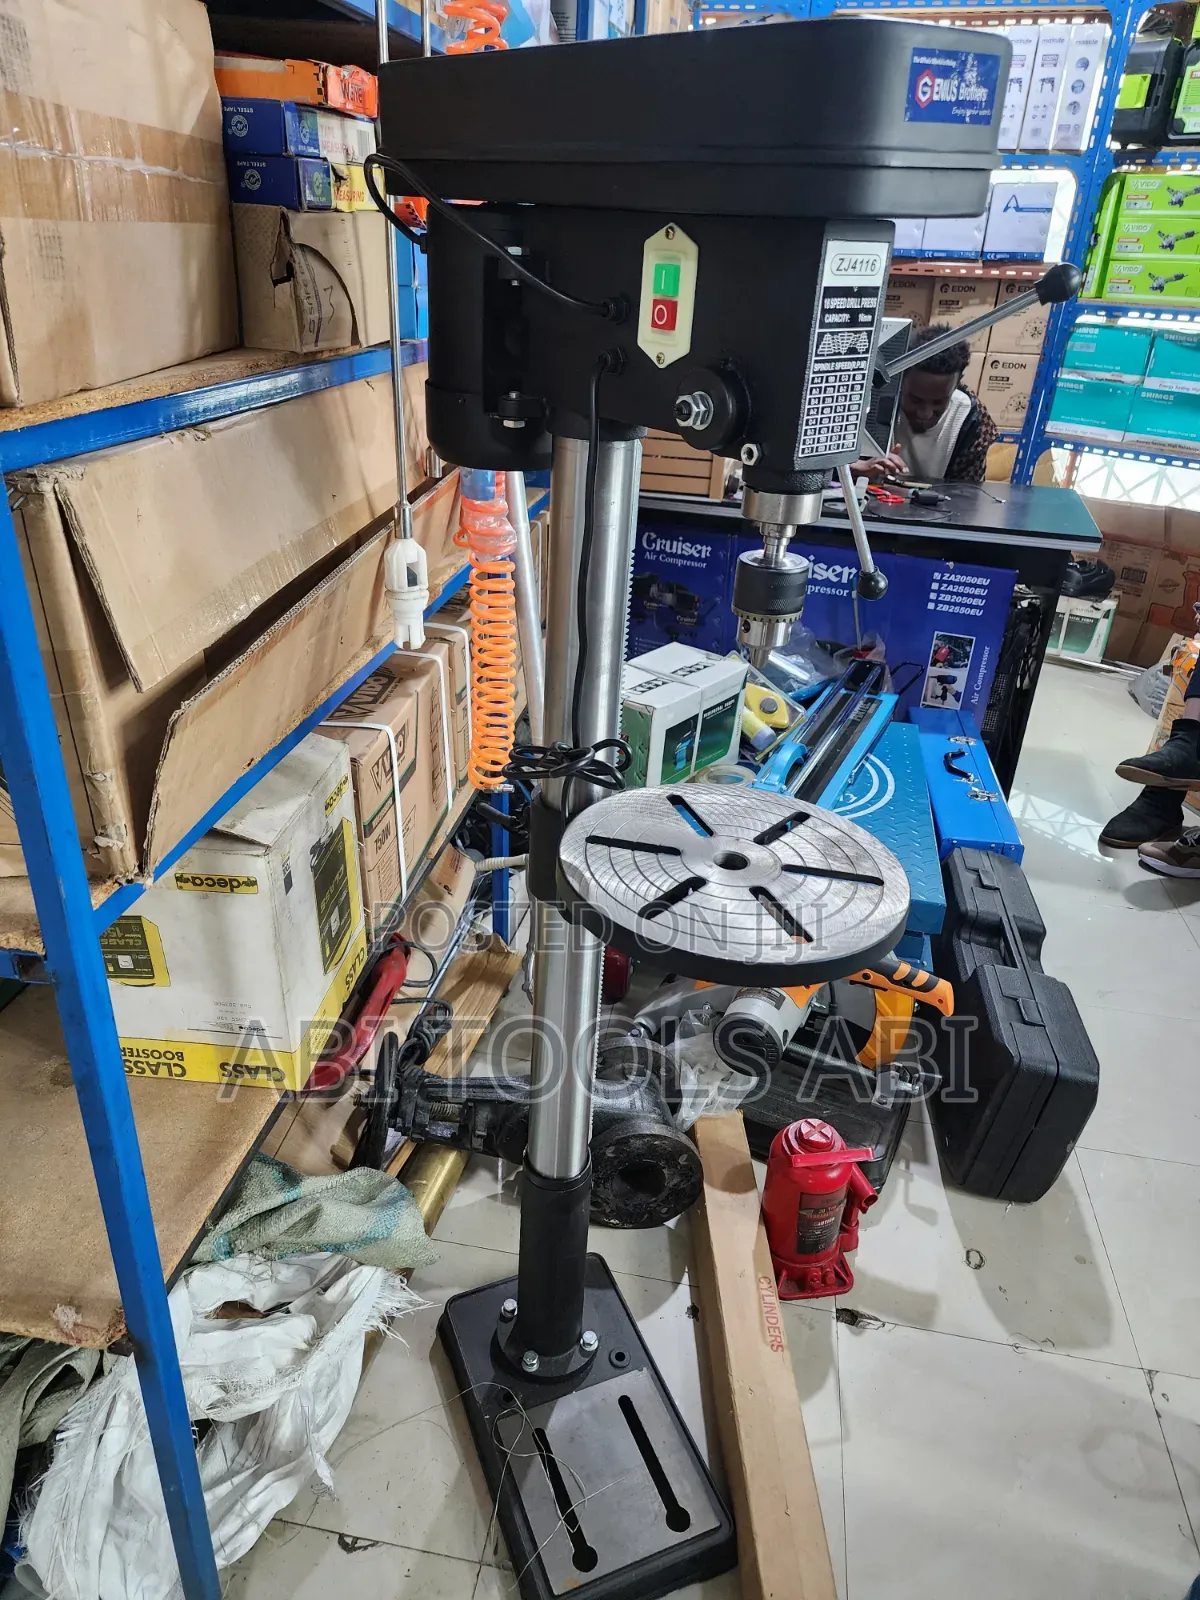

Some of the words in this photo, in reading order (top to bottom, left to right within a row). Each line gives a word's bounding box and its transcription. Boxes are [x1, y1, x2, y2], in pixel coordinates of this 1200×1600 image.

[836, 257, 878, 273] ZJ4116
[951, 285, 976, 293] EDON
[860, 296, 878, 308] PRESS
[1001, 361, 1027, 370] EDON
[1141, 391, 1175, 401] SHIMGE
[642, 531, 712, 558] Cruiser
[644, 551, 657, 561] Air
[659, 554, 707, 569] Compressor
[806, 554, 859, 584] iser
[942, 572, 990, 586] ZA2050EU
[804, 583, 849, 598] pressor
[940, 583, 988, 596] ZA2550EU
[938, 593, 986, 607] ZB2050EU
[936, 603, 984, 617] ZB2550EU
[973, 645, 990, 693] Compressor
[970, 693, 979, 705] Air
[374, 819, 392, 856] 750W
[189, 875, 242, 893] deca
[100, 937, 142, 946] CLASS
[344, 945, 366, 993] CLASS
[120, 1047, 184, 1061] BOOSTER
[122, 1058, 187, 1078] CLASS
[219, 1061, 286, 1082] CLASS
[758, 1276, 785, 1353] CYLINDERS
